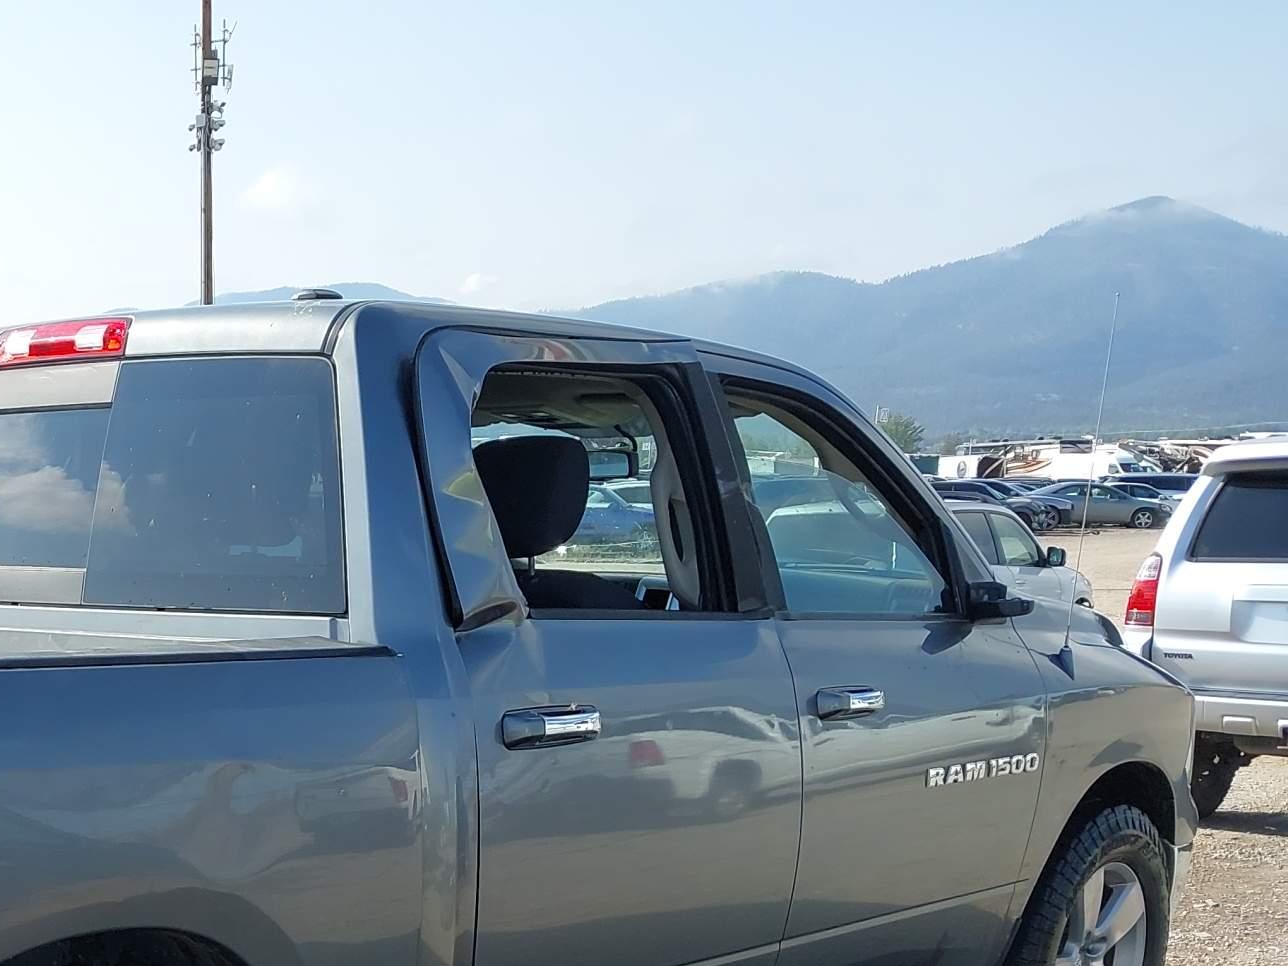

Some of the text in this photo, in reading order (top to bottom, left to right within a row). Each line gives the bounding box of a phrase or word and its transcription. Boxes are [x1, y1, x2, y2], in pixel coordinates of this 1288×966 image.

[1163, 652, 1194, 660] TOYOTA
[925, 752, 1040, 788] RAM 1500
